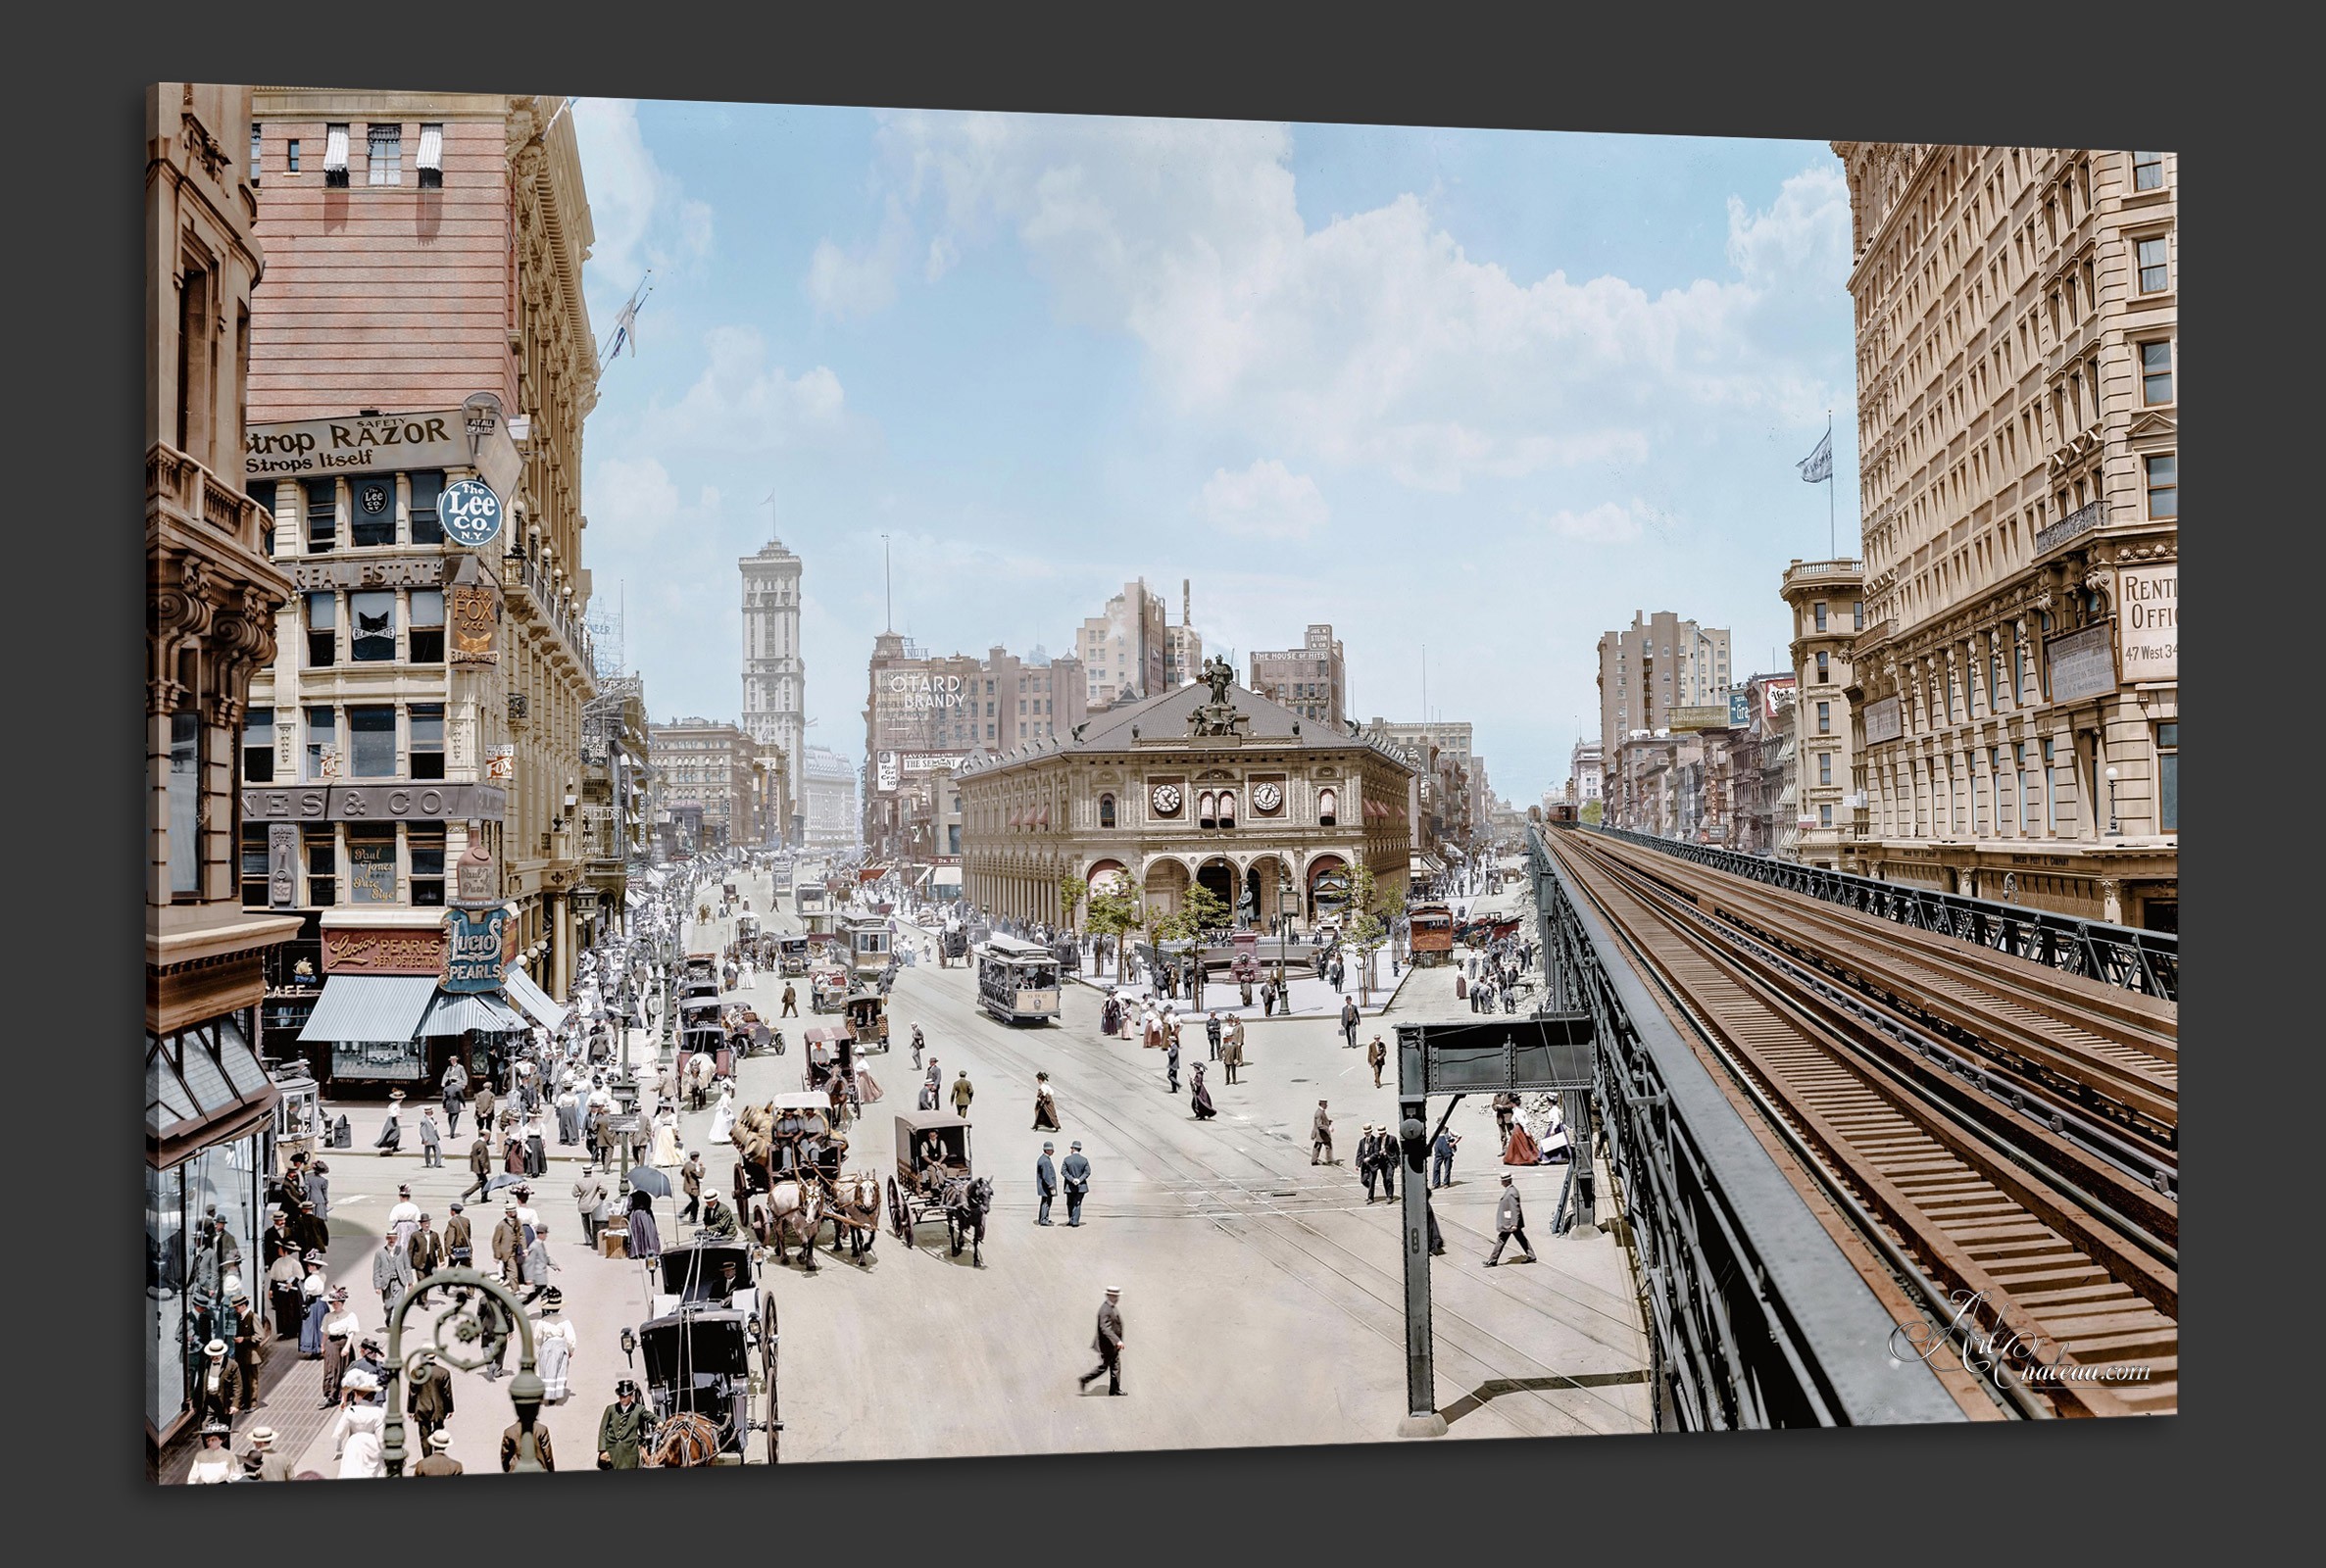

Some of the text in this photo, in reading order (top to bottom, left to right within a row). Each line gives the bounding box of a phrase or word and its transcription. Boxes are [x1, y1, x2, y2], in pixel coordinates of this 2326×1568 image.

[356, 417, 406, 427] SAFETY
[482, 418, 495, 427] ALL
[329, 418, 451, 449] RAZOR
[246, 449, 373, 472] Strops Itself
[365, 490, 383, 502] Lee
[461, 483, 484, 495] The
[449, 491, 496, 516] Lee
[454, 515, 492, 531] CO.
[461, 531, 484, 540] N.Y.
[295, 561, 442, 588] REAL ESTATE
[454, 598, 494, 622] FOX
[461, 620, 486, 632] & CO.
[2125, 646, 2139, 662] 47
[2141, 645, 2163, 661] West
[890, 675, 961, 693] OTARD
[905, 694, 965, 709] BRANDY
[486, 758, 513, 778] FOX
[343, 790, 366, 815] &
[388, 789, 453, 815] CO.
[354, 847, 381, 860] Paul
[360, 859, 393, 878] Jones
[353, 877, 380, 889] Pure
[379, 939, 440, 956] PEARLS
[450, 918, 503, 962] LUCIOS
[373, 956, 440, 969] DEFY DETECTION
[449, 963, 501, 981] PEARLS
